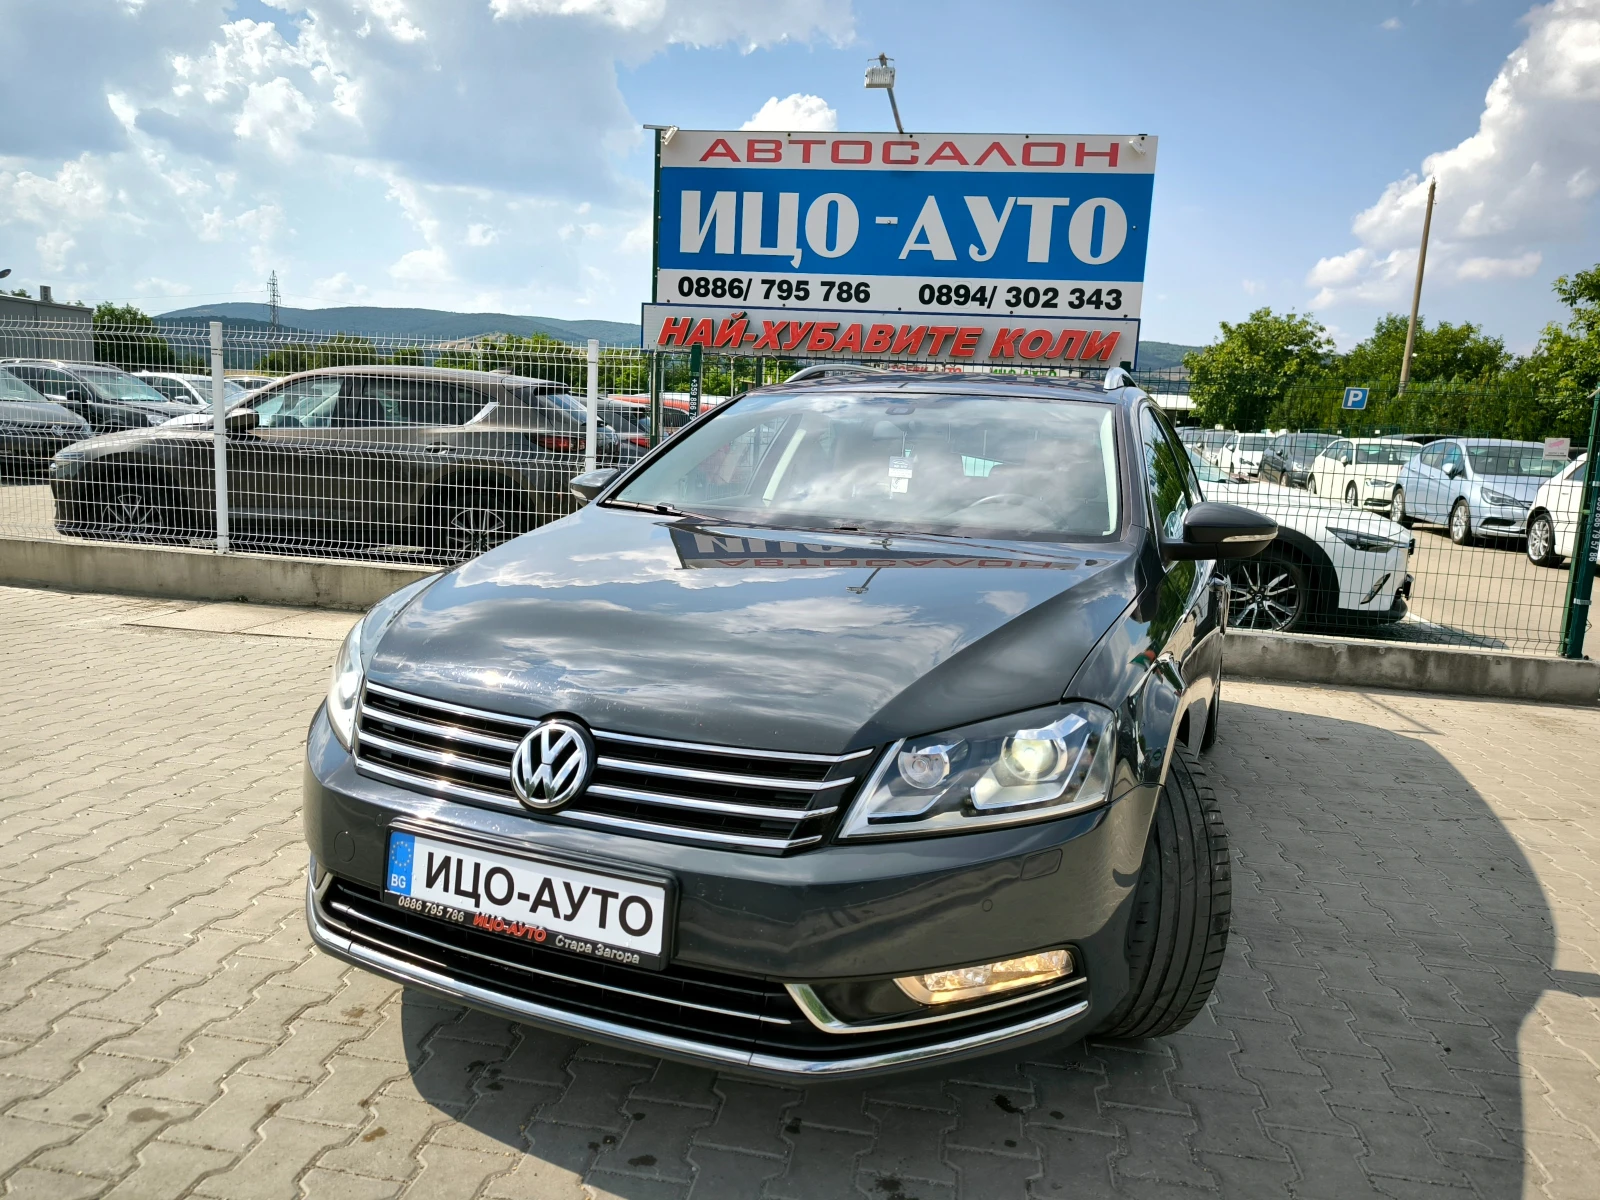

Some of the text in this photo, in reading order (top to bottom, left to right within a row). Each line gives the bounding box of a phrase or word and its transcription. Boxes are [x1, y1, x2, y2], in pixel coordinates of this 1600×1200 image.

[699, 138, 1120, 168] АВТОСАЛОН
[678, 276, 871, 303] 0886/ 795 786
[918, 283, 1123, 310] 0894/ 302 343
[657, 311, 1122, 362] НАЙ-ХУБАВИТЕ КОЛИ
[690, 378, 698, 396] +359
[1347, 390, 1363, 407] P
[1592, 529, 1600, 539] 79
[1590, 541, 1599, 550] 57
[1588, 552, 1598, 562] 86
[391, 873, 406, 889] BG
[425, 851, 654, 937] ИЦО-АУТО
[397, 895, 641, 965] 0886 795 786 ИЦО-АУТО Стара Загора
